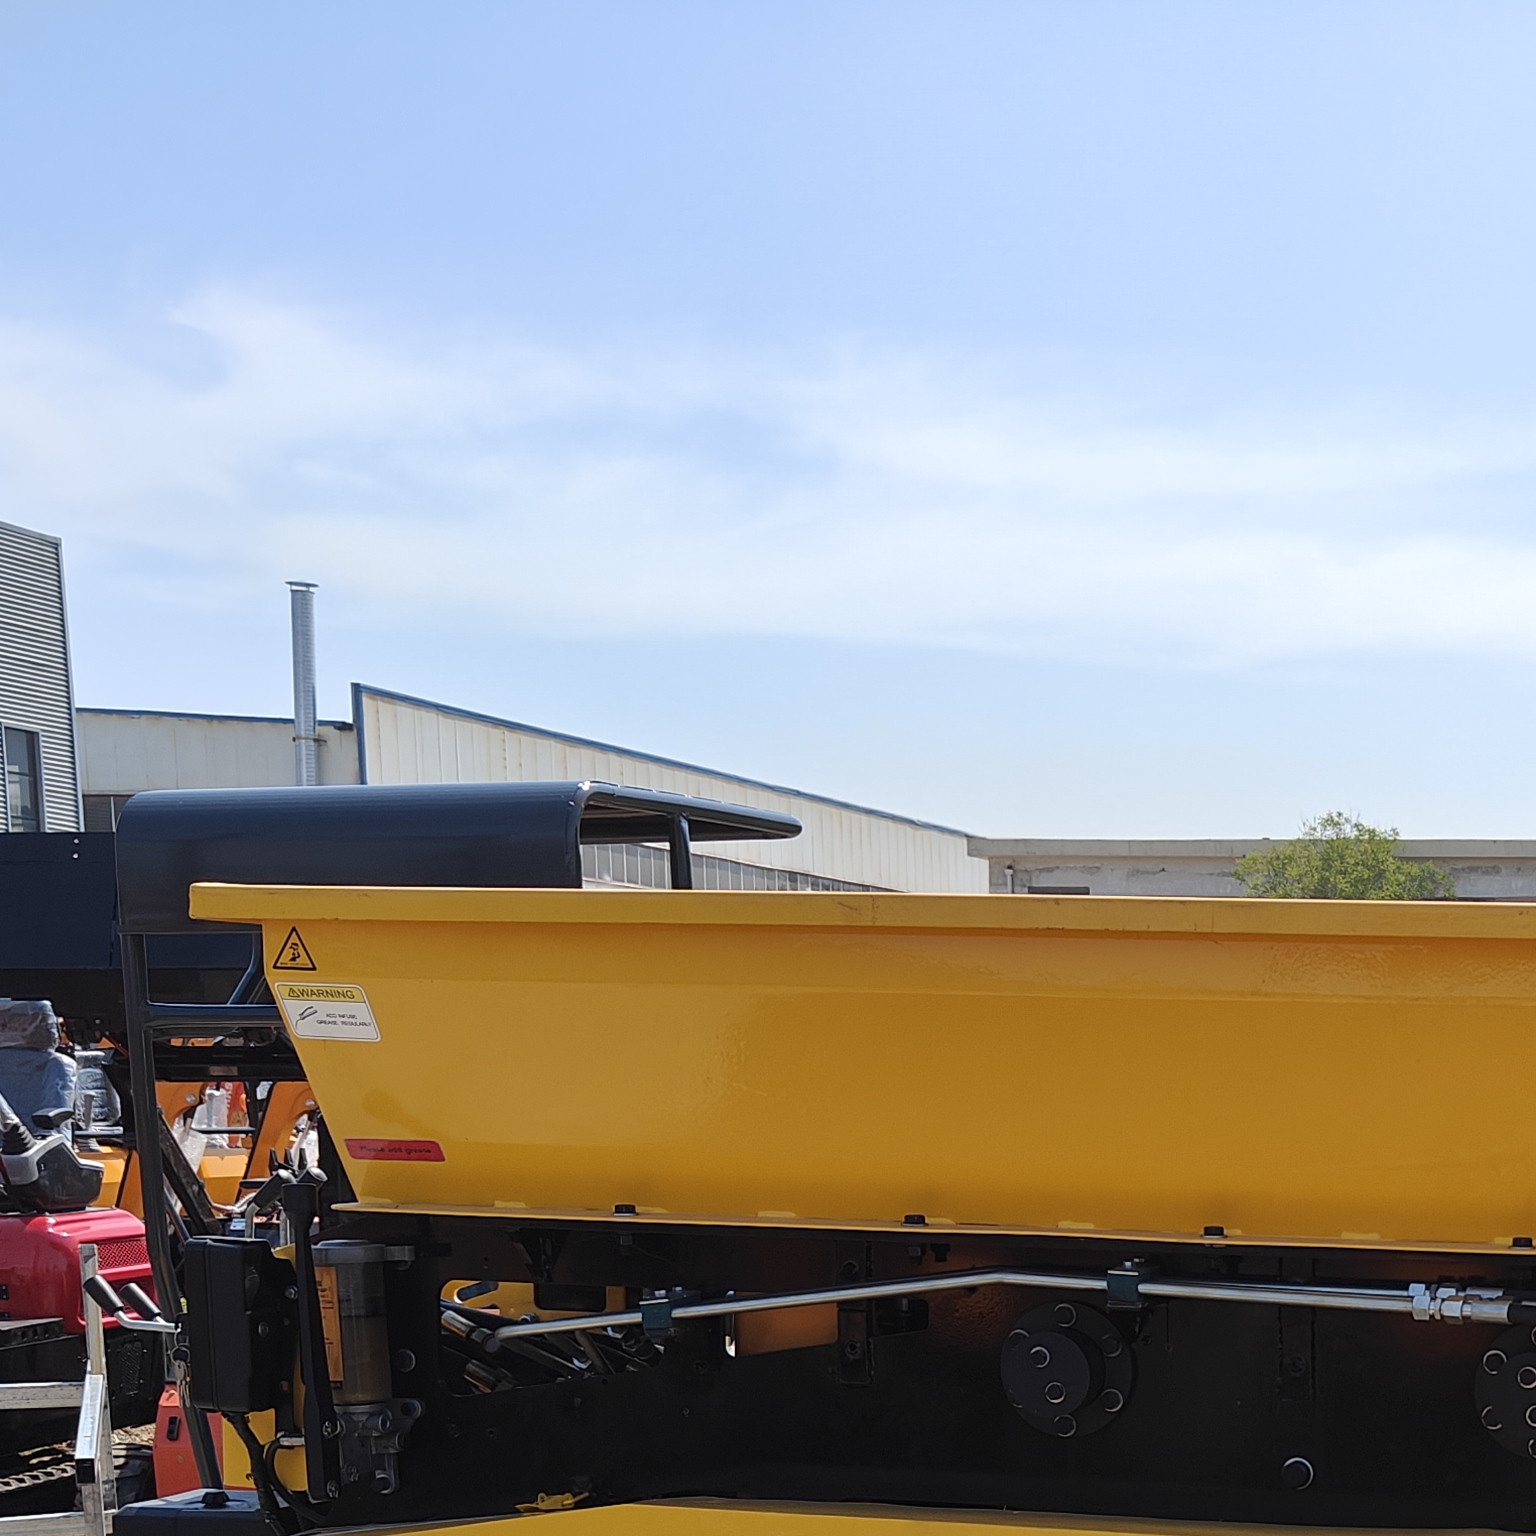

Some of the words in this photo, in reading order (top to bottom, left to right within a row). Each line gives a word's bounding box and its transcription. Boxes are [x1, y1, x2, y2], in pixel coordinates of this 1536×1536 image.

[298, 988, 355, 1000] WARNING
[359, 1145, 385, 1153] Please
[405, 1147, 431, 1155] grease
